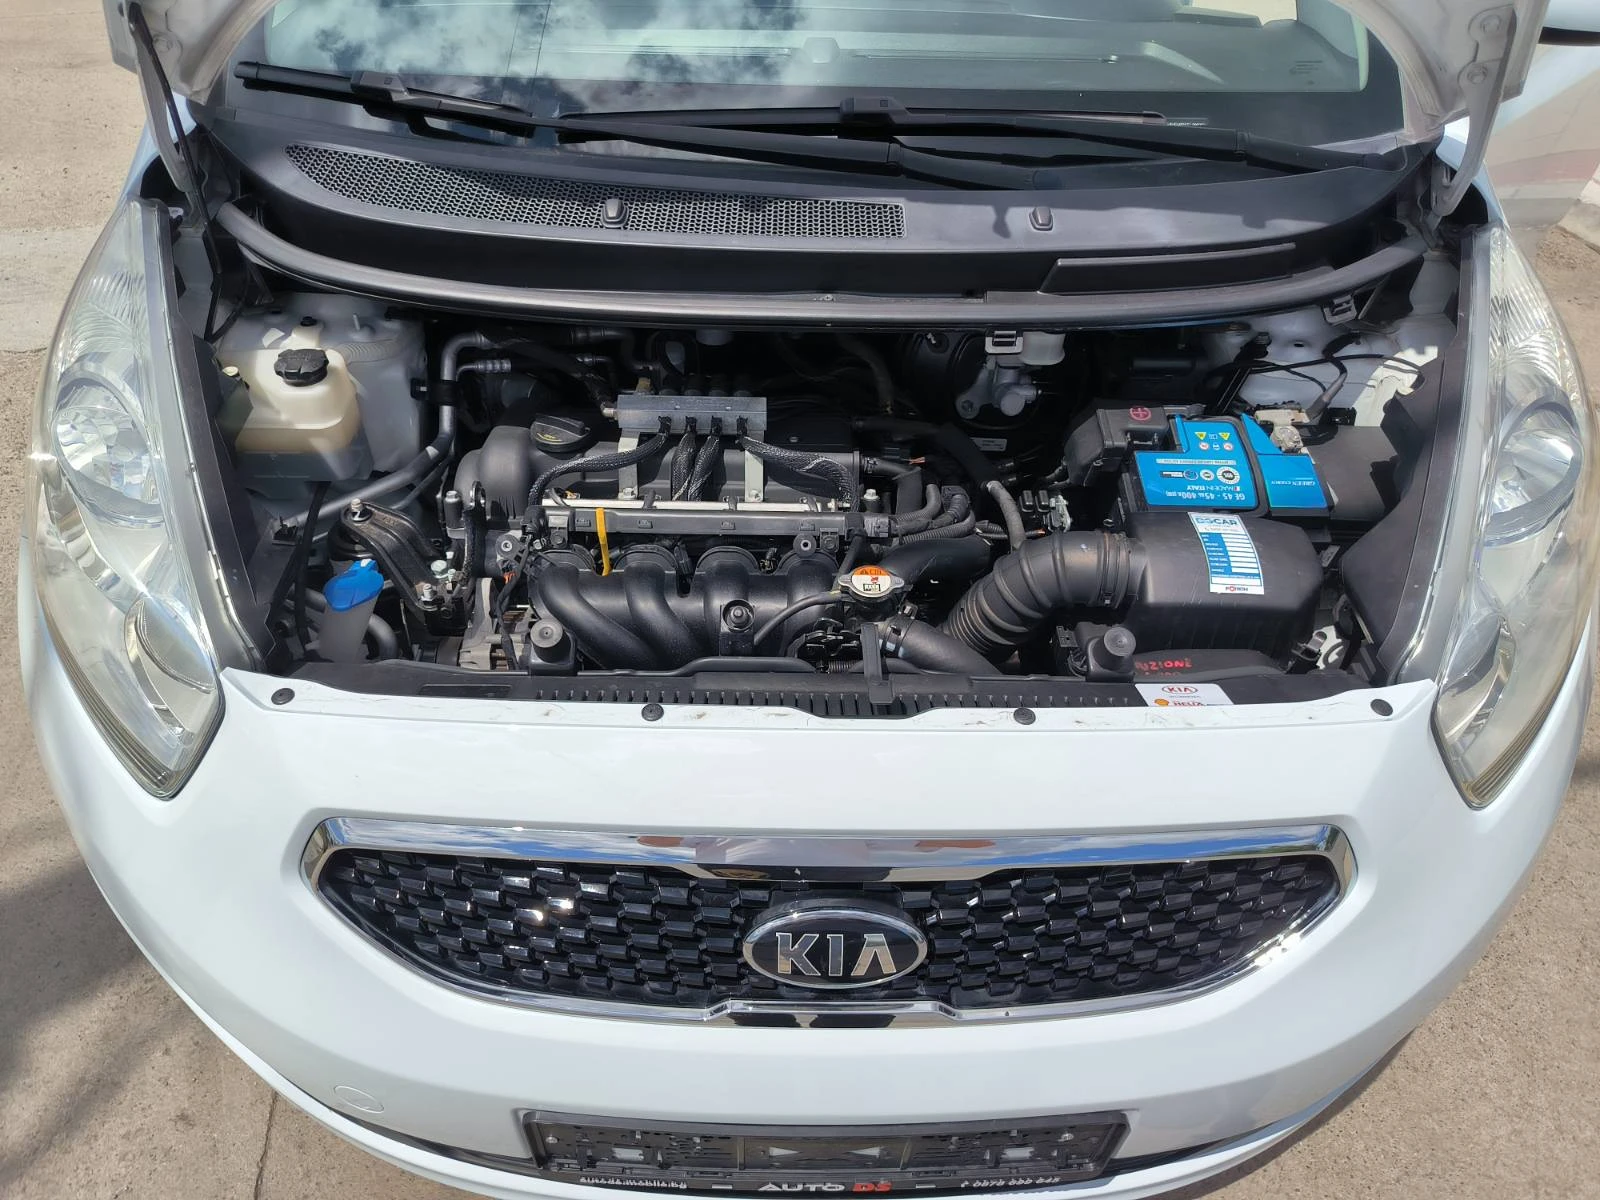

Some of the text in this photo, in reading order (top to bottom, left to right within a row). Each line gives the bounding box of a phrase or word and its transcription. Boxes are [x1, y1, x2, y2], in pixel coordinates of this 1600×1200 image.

[775, 932, 897, 977] KIA
[757, 1181, 893, 1193] AUTO DS
